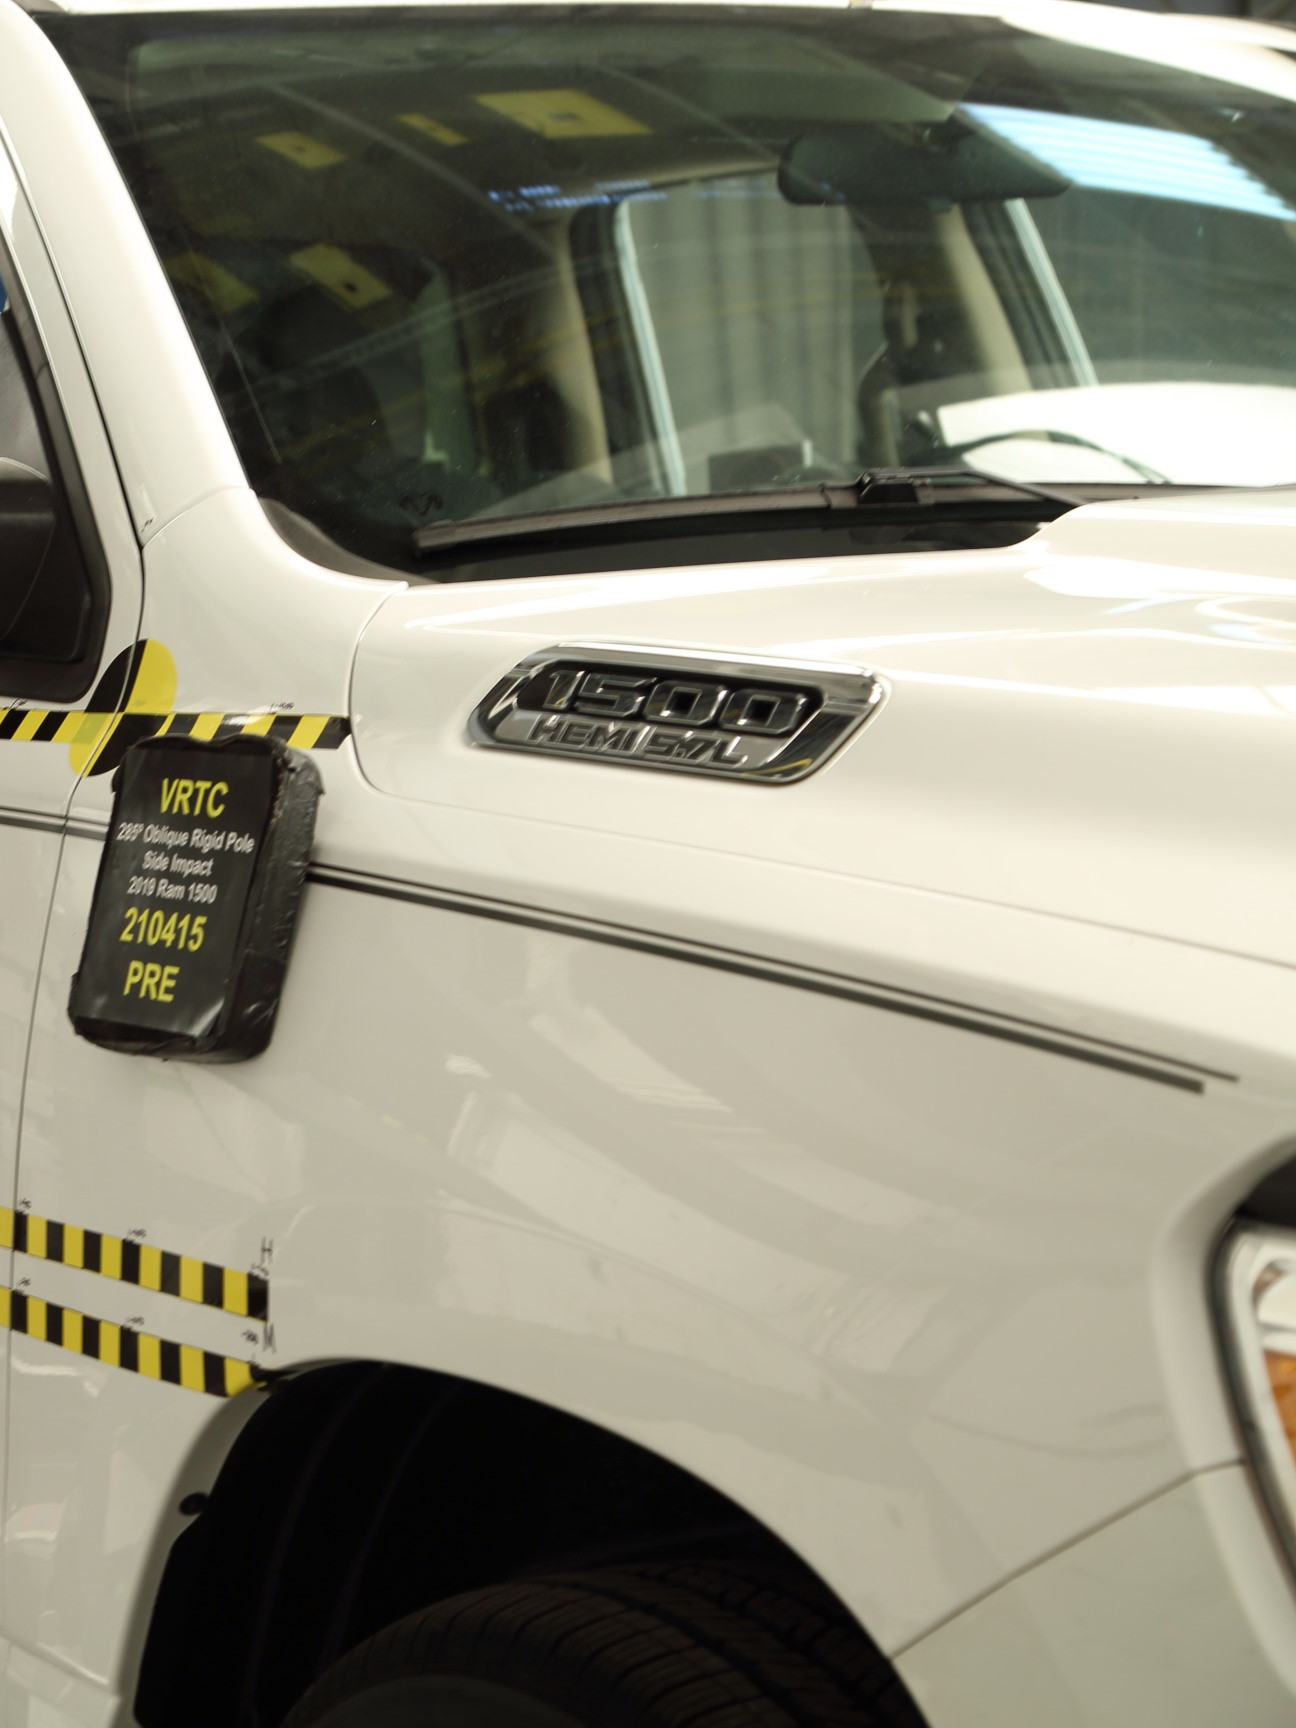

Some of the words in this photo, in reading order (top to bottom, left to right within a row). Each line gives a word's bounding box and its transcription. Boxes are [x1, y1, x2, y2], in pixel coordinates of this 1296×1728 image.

[539, 669, 807, 735] 1500
[526, 713, 649, 753] HEMI
[644, 725, 749, 769] 5.7L
[160, 777, 229, 819] VRTC
[143, 823, 189, 850] Oblique
[189, 828, 226, 854] Rigid
[224, 831, 255, 854] Pole
[142, 850, 170, 871] Side
[169, 853, 215, 879] Impact
[126, 875, 157, 897] 2019
[155, 878, 186, 901] Ram
[187, 882, 218, 905] 1500
[119, 906, 207, 952] 210415
[123, 960, 180, 1003] PRE
